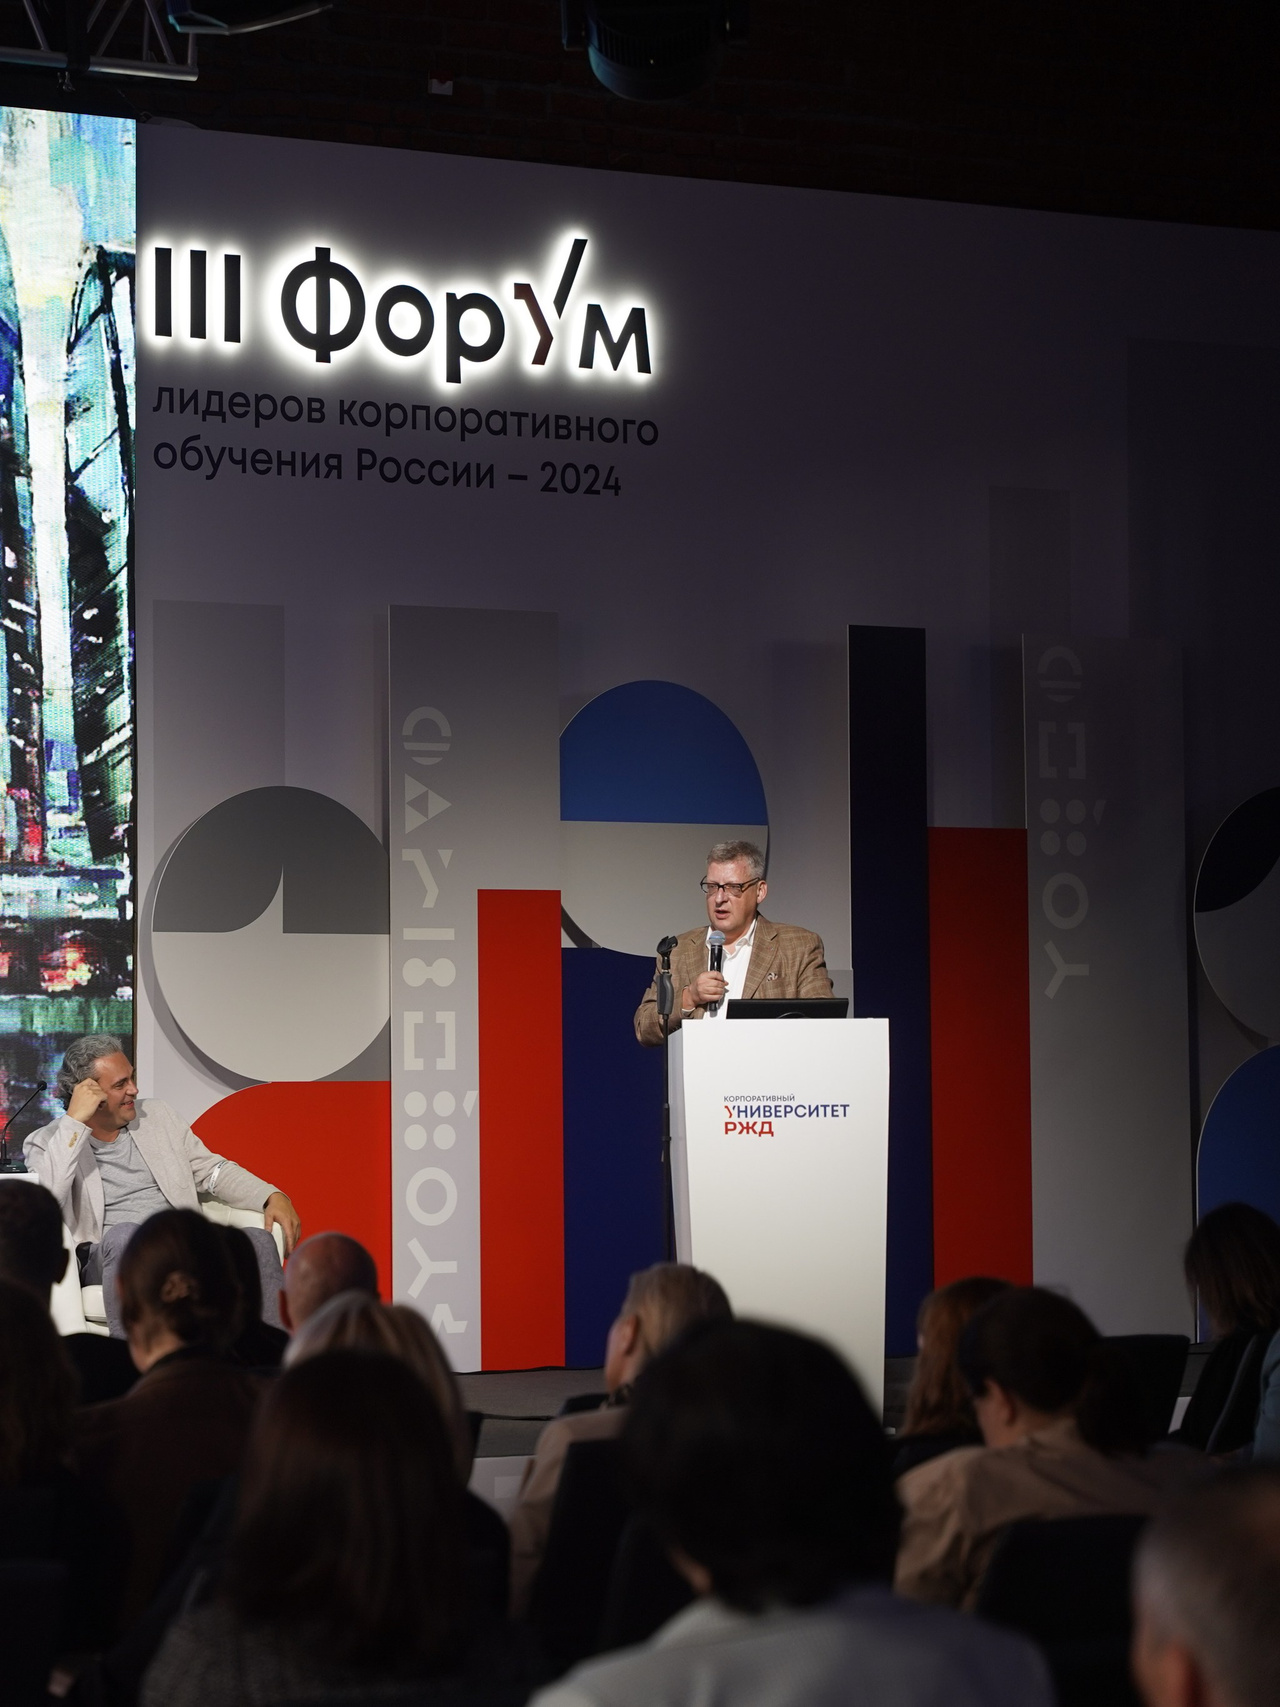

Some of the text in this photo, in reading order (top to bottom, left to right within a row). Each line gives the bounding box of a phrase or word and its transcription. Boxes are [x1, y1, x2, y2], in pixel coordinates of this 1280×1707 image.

[152, 385, 659, 447] лидеров корпоративного
[152, 435, 343, 481] обучения
[357, 447, 495, 490] России
[539, 462, 622, 497] 2024
[723, 1093, 796, 1103] КОРПОРАТИВНЫЙ
[724, 1104, 850, 1119] УНИВЕРСИТЕТ
[724, 1121, 774, 1137] РЖД
